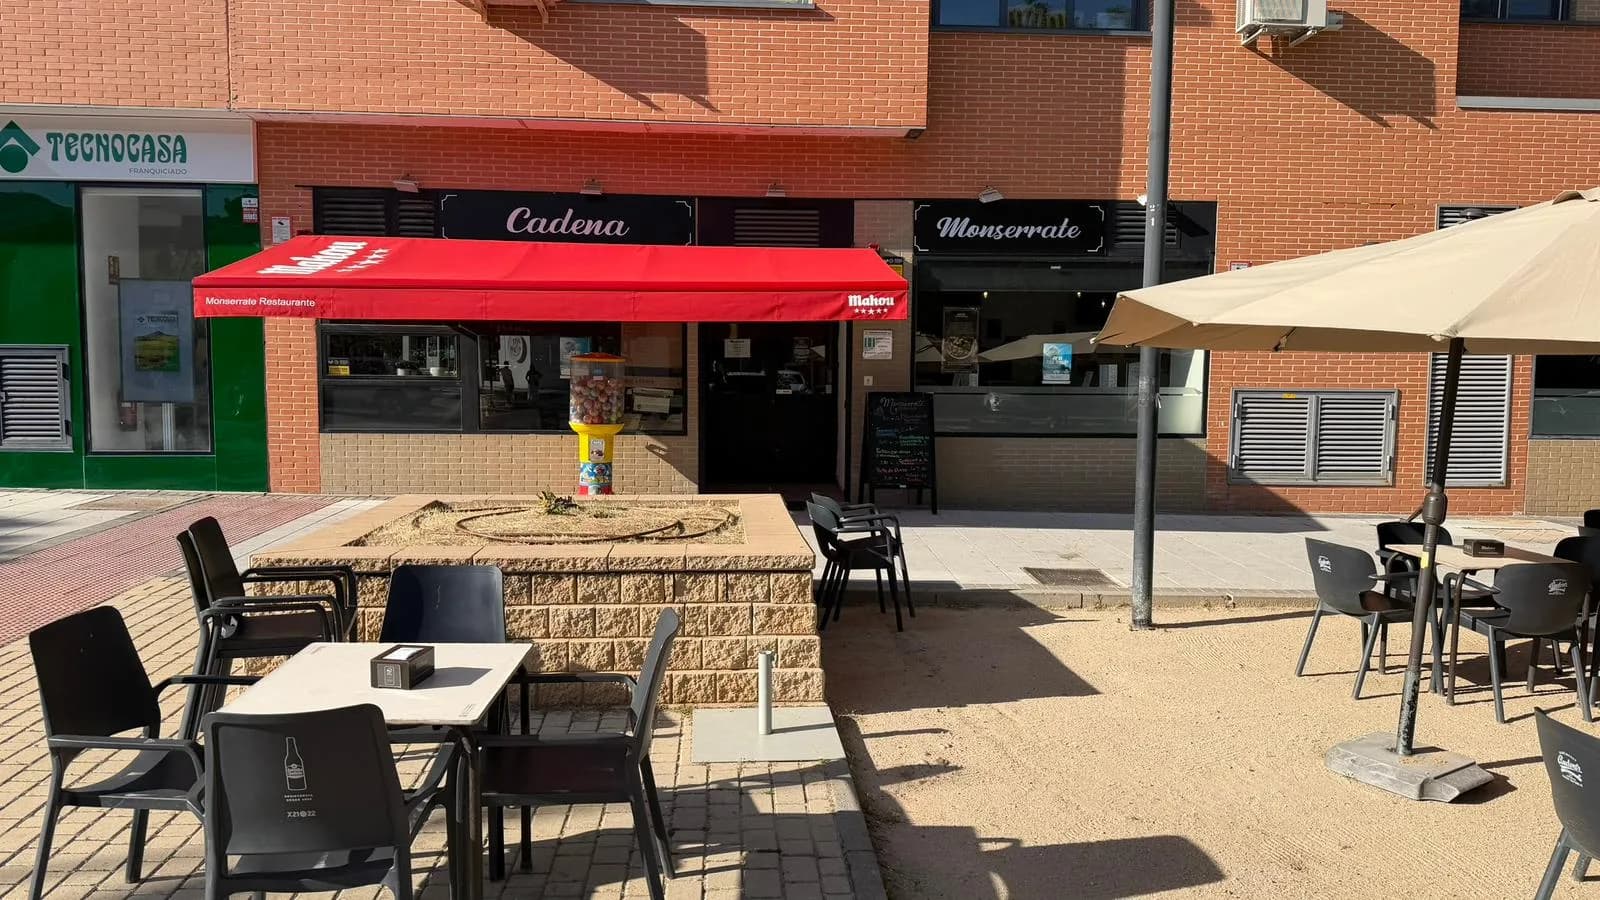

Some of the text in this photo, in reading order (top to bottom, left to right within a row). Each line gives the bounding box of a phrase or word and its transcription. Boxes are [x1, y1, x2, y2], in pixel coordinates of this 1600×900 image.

[46, 132, 187, 163] TECNOCASA
[129, 167, 188, 175] FRANQUICIADO
[506, 206, 630, 236] Cadena
[936, 217, 1081, 239] Monserrate
[205, 297, 316, 307] Monserrate Restaurante
[848, 294, 895, 306] Mahou
